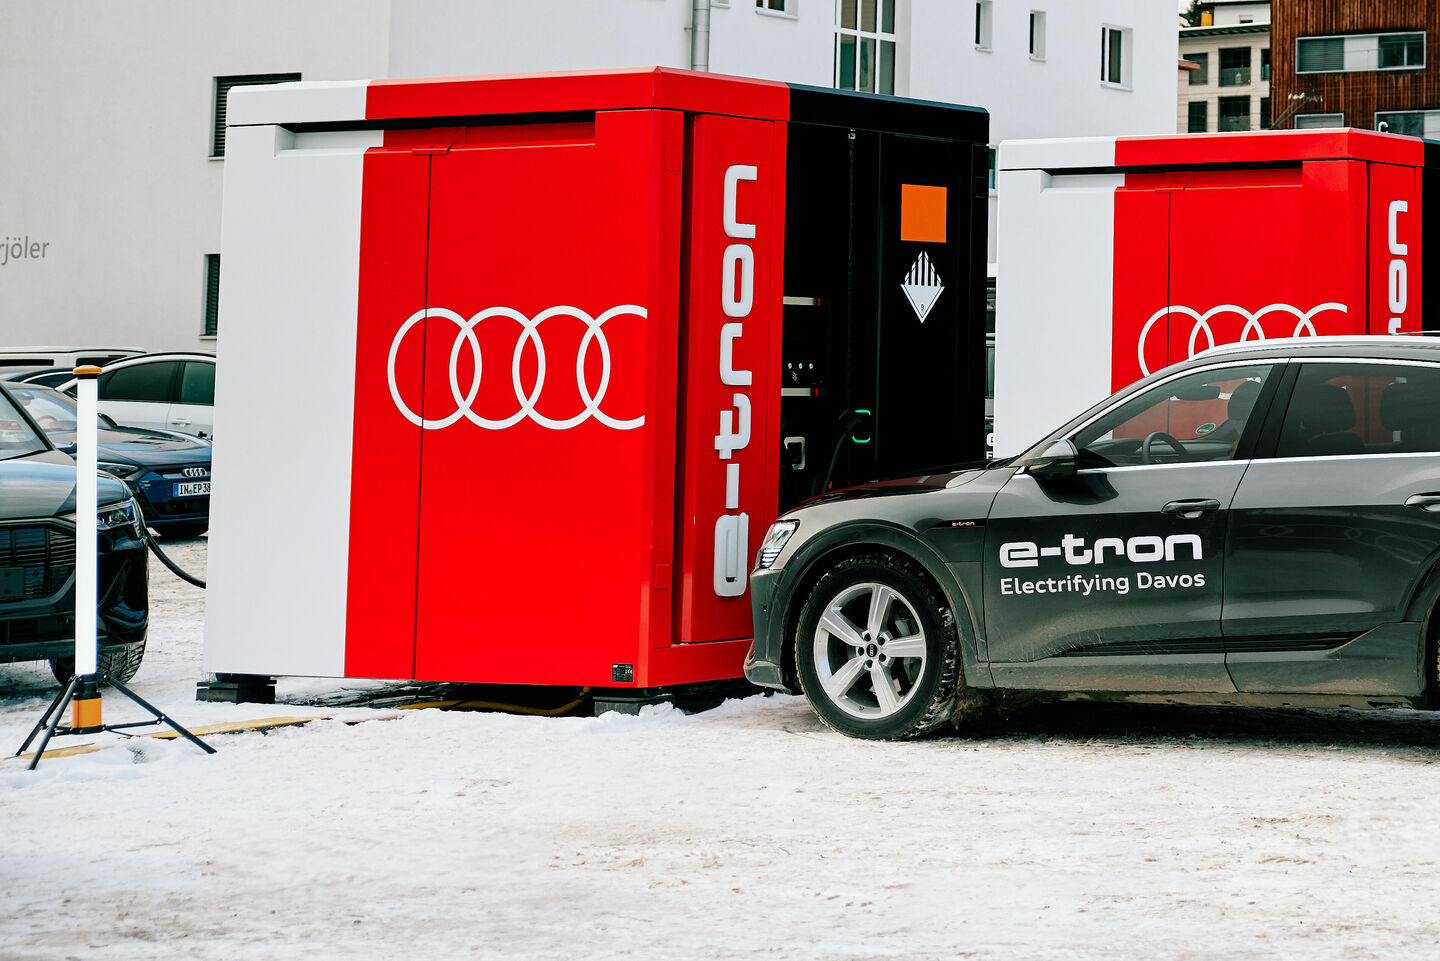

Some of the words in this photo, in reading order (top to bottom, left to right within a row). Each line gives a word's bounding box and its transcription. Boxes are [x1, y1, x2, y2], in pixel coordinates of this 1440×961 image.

[1000, 533, 1203, 568] e-tron
[1000, 574, 1130, 596] Electrifying
[1136, 571, 1206, 590] Davos
